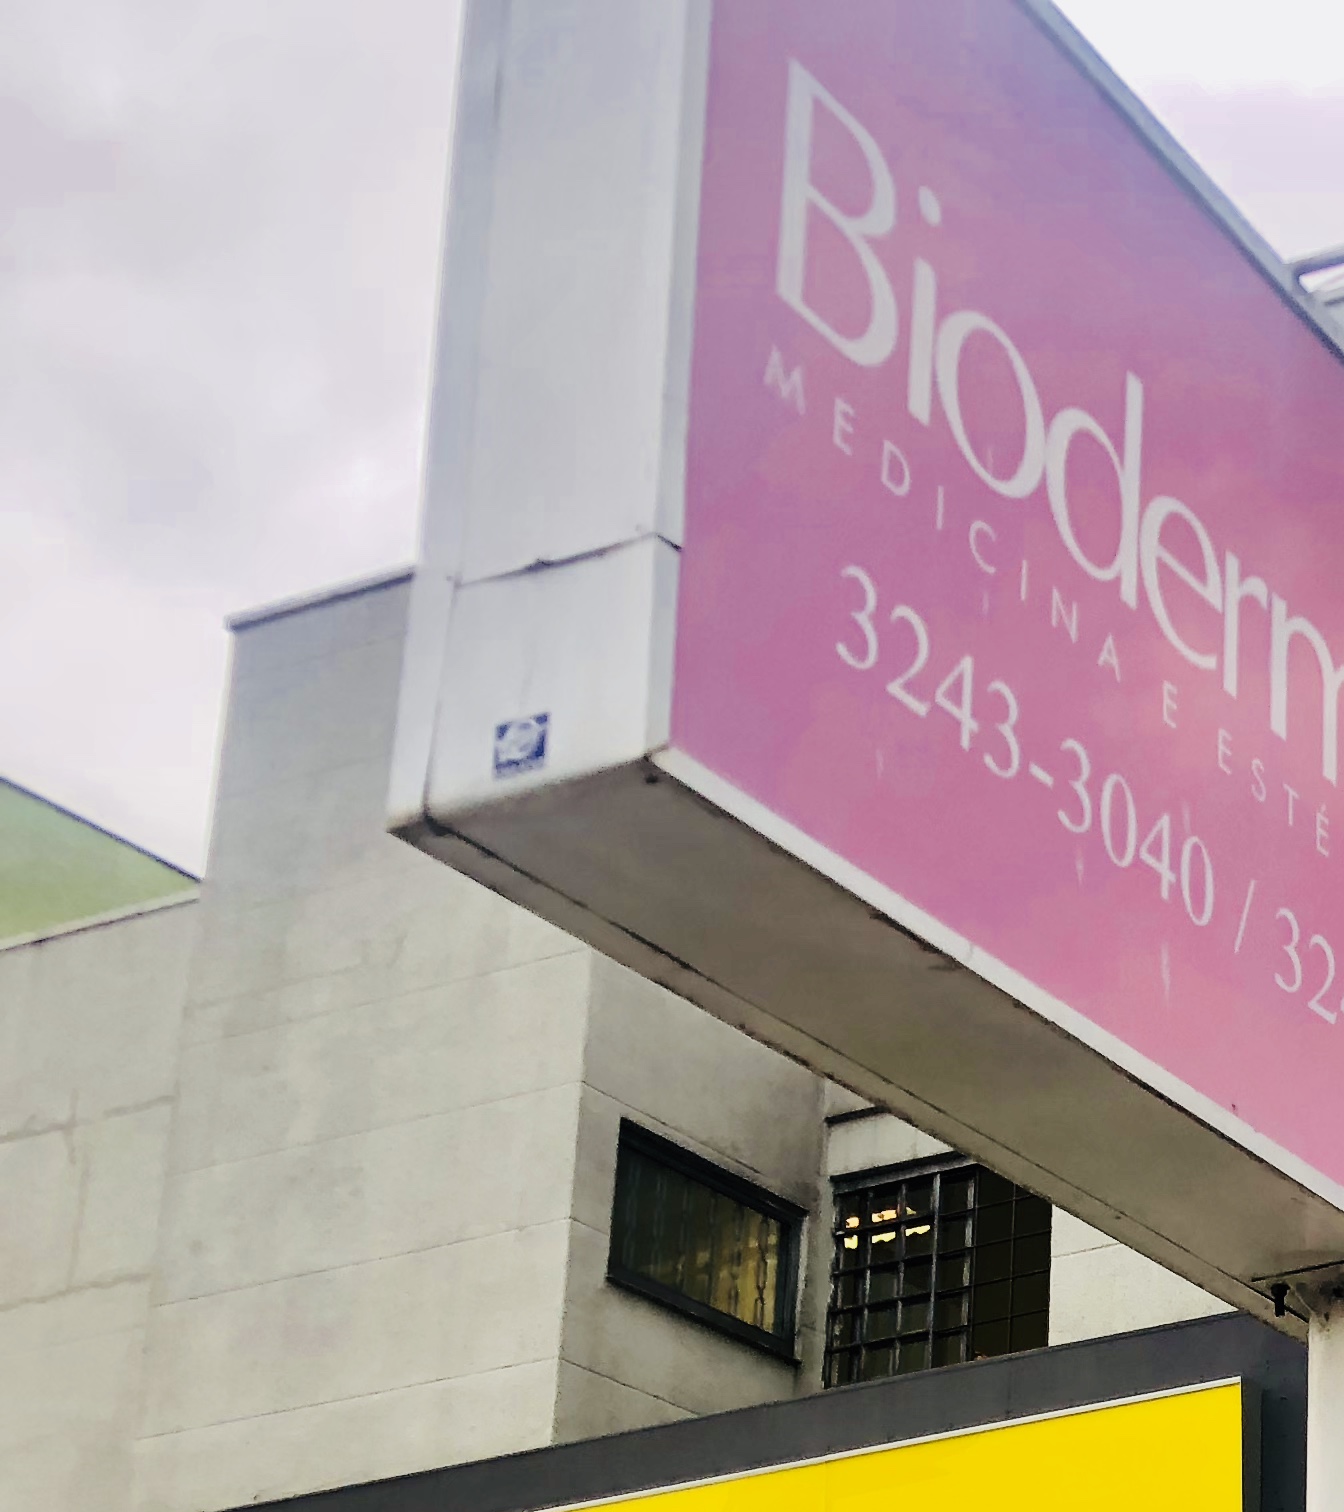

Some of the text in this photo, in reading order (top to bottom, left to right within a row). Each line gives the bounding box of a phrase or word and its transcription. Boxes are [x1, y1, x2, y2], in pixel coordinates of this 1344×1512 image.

[762, 343, 1122, 684] MEDICINA
[1162, 679, 1178, 729] E
[835, 564, 1214, 926] 3243-3040
